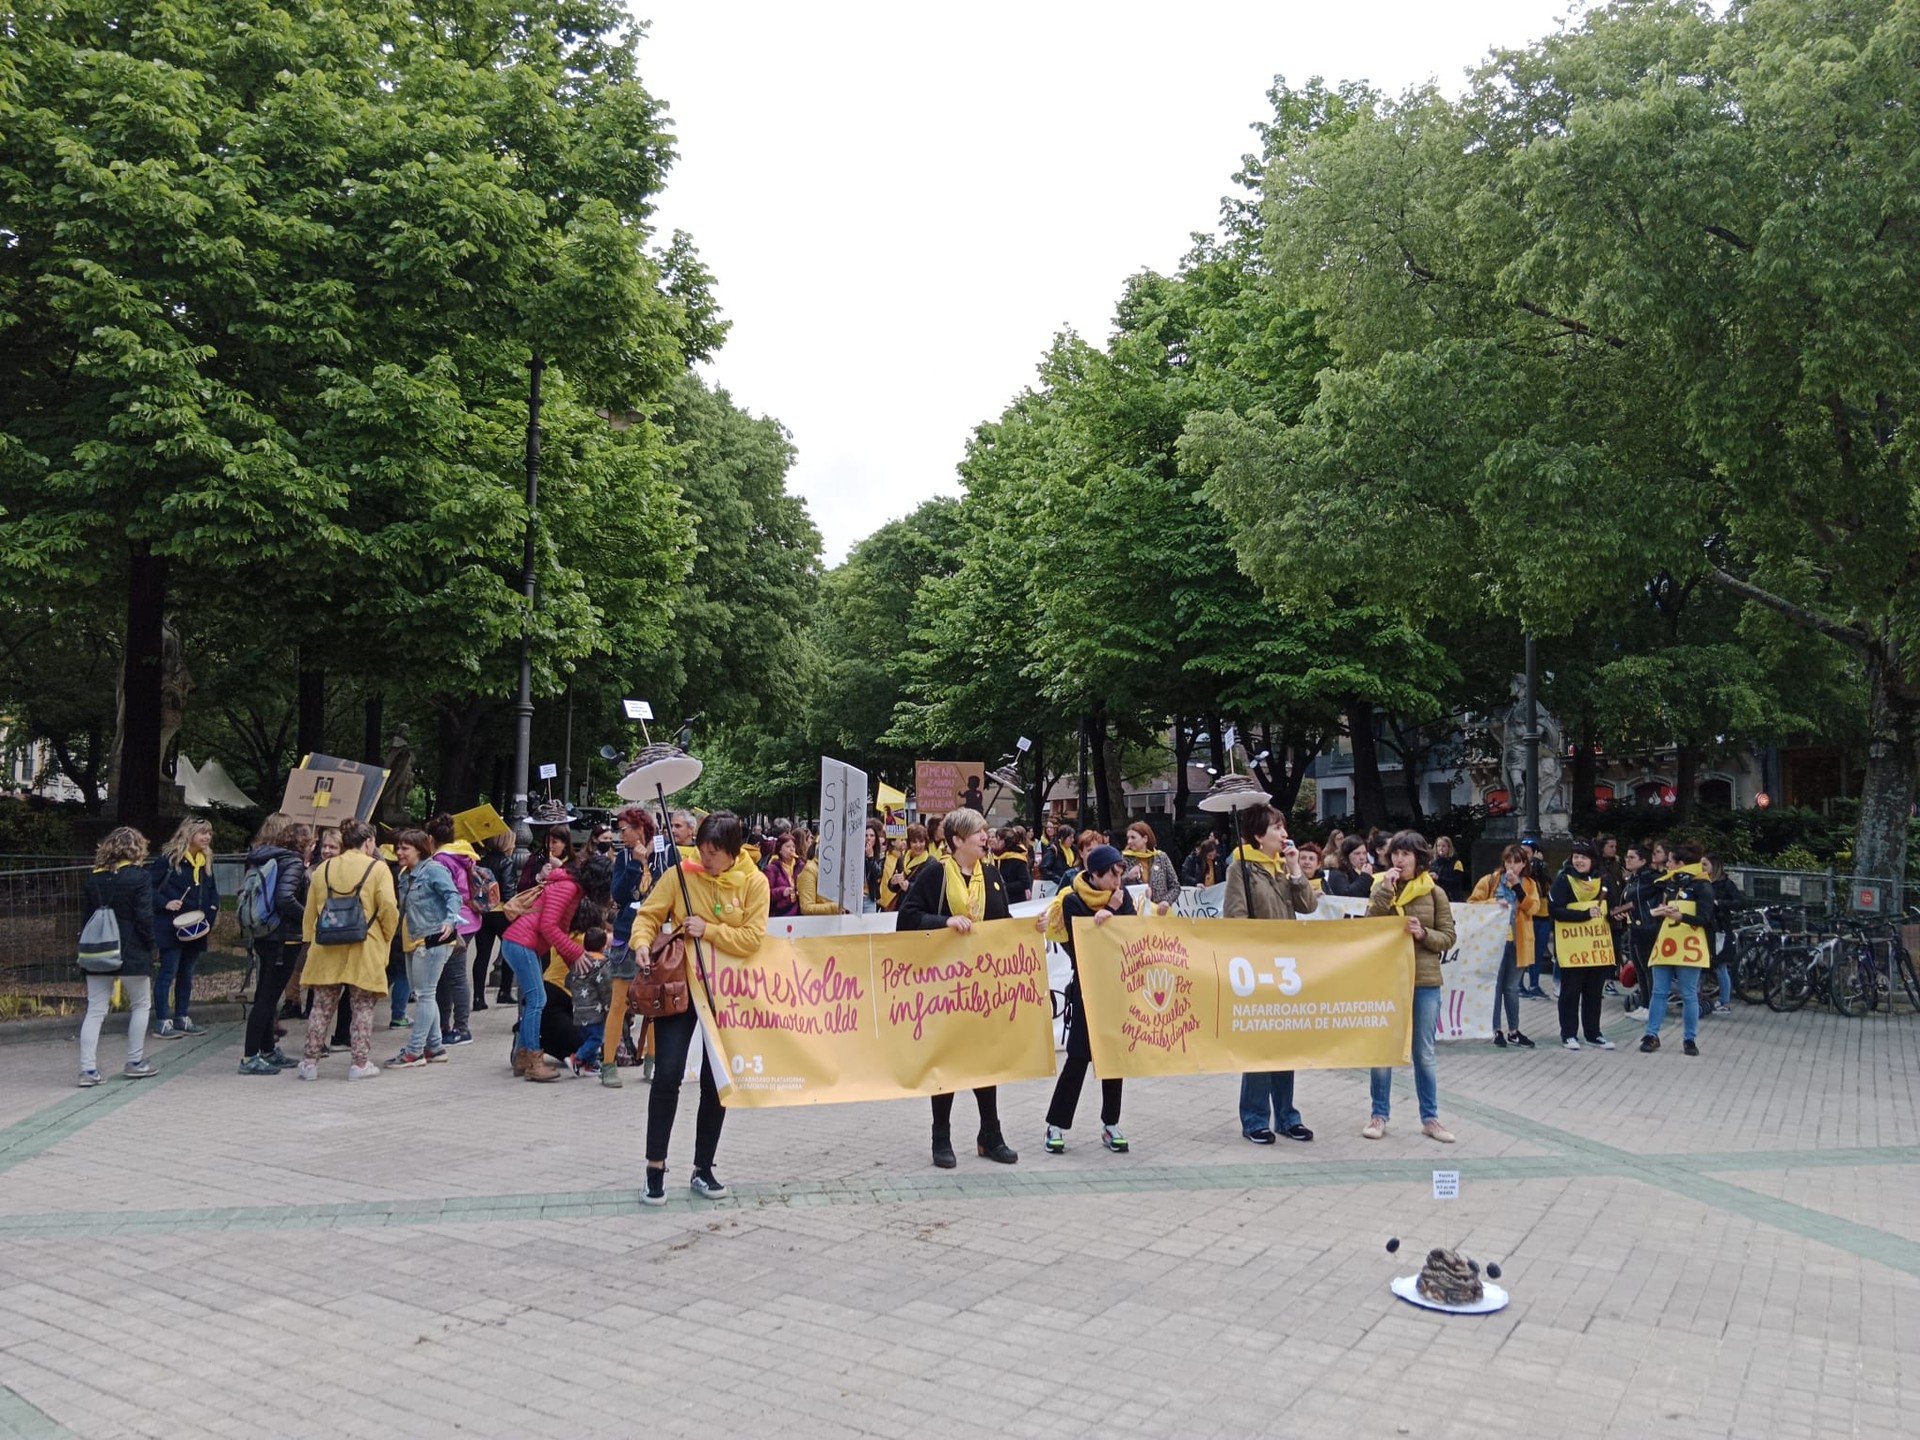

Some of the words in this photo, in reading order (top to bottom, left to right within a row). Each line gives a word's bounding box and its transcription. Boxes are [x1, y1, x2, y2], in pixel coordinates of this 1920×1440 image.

[882, 958, 913, 993] Por
[912, 961, 973, 985] unas
[975, 943, 1041, 979] escuelas
[1228, 956, 1303, 997] 0-3
[824, 1003, 858, 1034] alde
[889, 981, 992, 1041] infantiles
[992, 978, 1044, 1022] dignas
[1232, 1003, 1317, 1017] NAFARROAKO
[1320, 1001, 1396, 1015] PLATAFORMA
[1232, 1018, 1312, 1032] PLATAFORMA
[1315, 1017, 1329, 1030] DE
[1332, 1015, 1389, 1029] NAVARRA
[731, 1055, 764, 1075] 0-3
